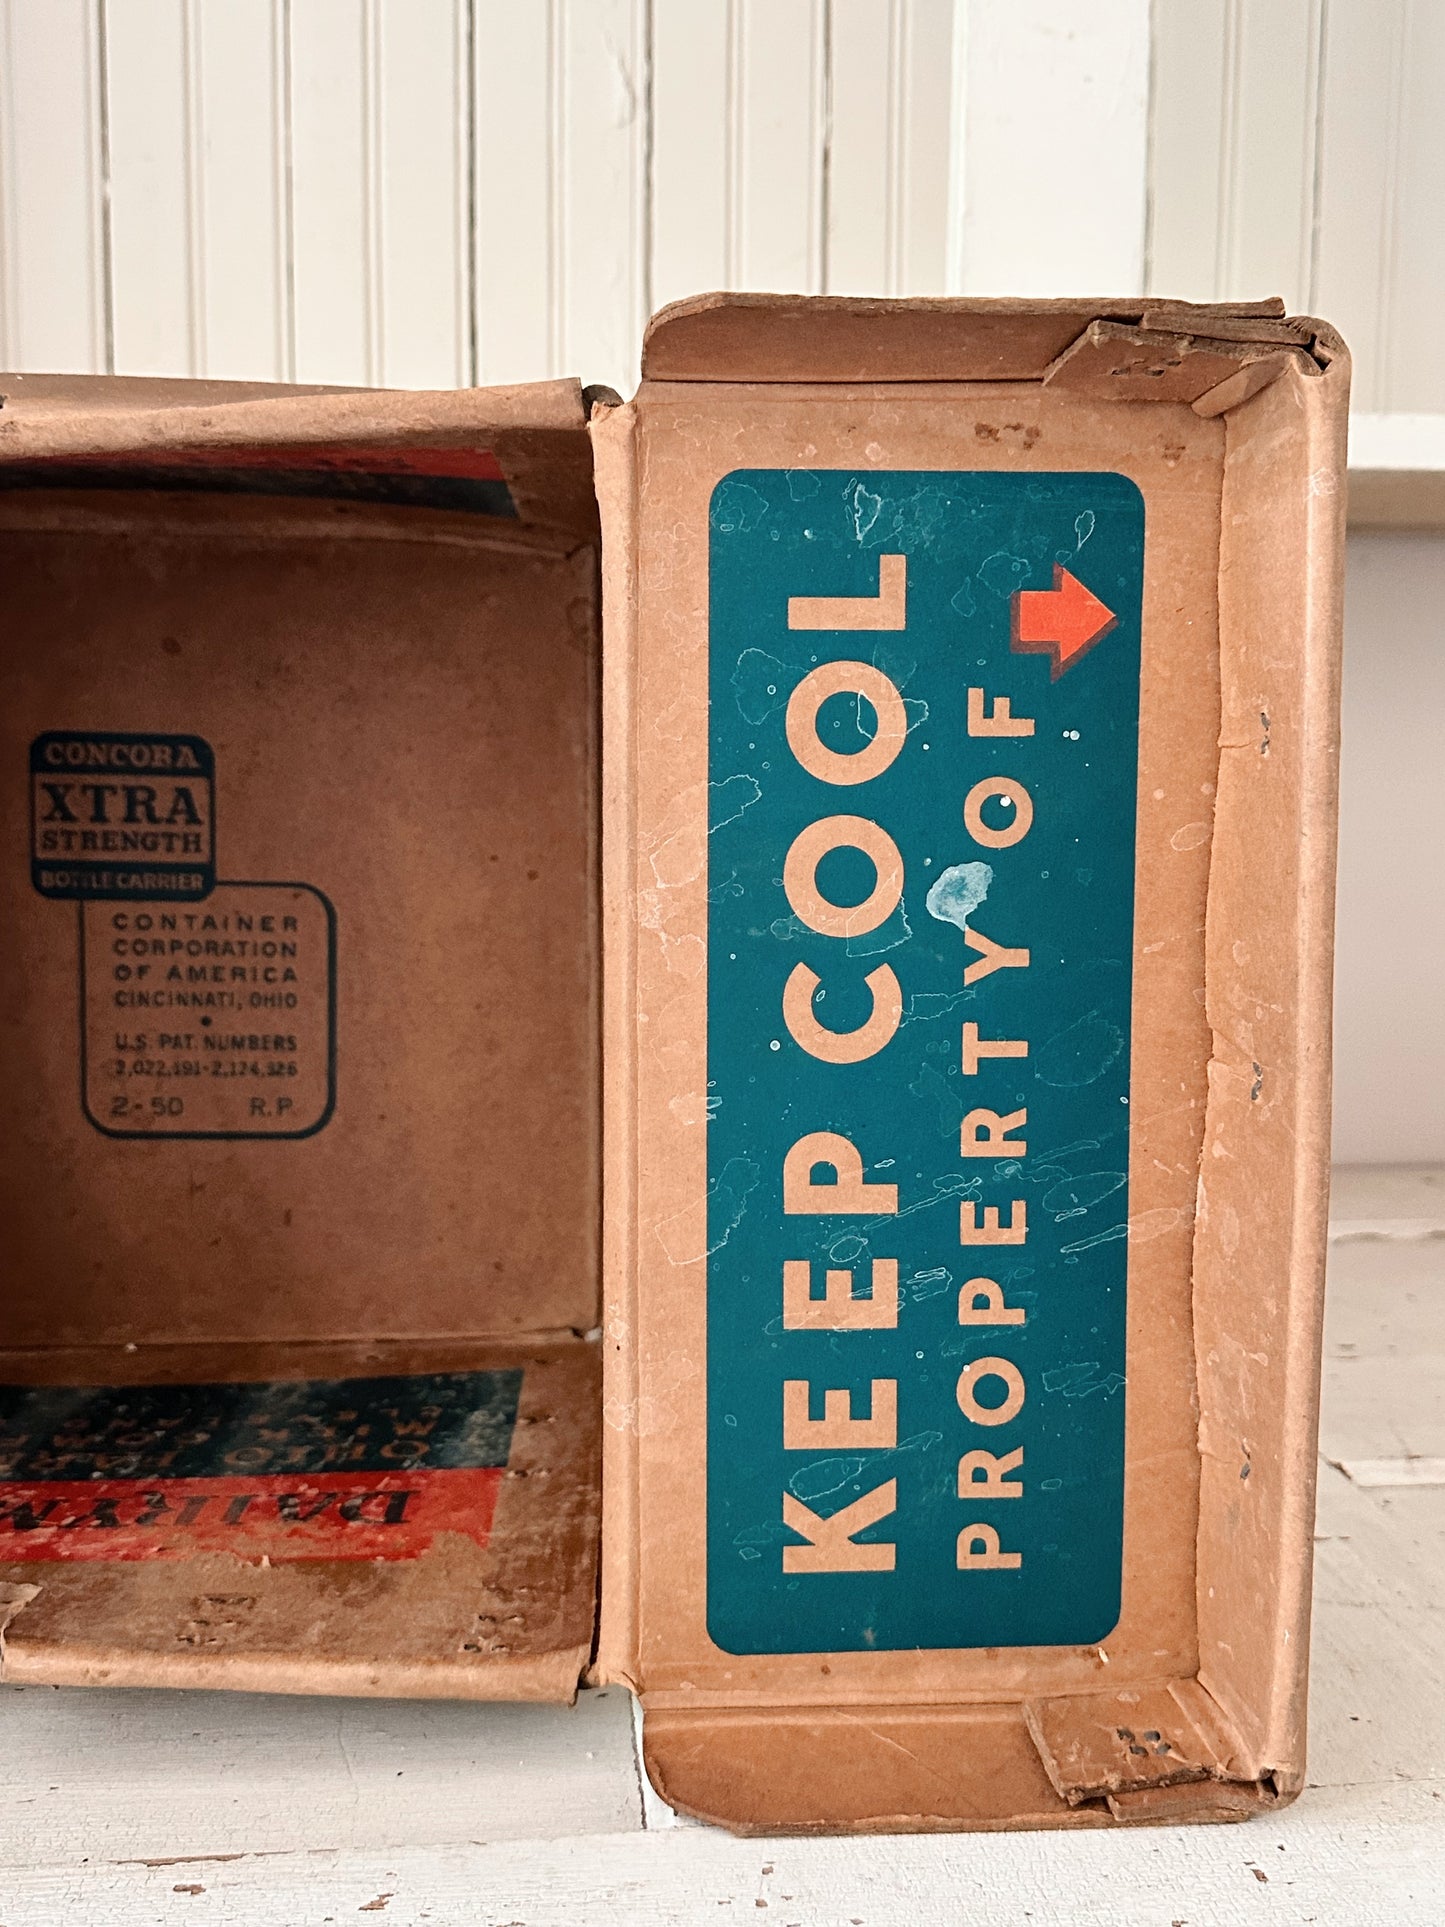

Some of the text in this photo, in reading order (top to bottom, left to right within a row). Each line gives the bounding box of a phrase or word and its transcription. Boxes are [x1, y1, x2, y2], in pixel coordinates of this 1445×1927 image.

[44, 742, 200, 768] CONCORA
[41, 782, 204, 826] XTRA
[40, 829, 204, 854] STRENGTH
[115, 872, 204, 891] CARRIER
[113, 912, 299, 933] CONTAINER
[113, 938, 298, 958] CORPORATION
[114, 963, 298, 983] OF AMERICA
[114, 989, 298, 1010] CINCINNATI, OHIO
[203, 1034, 298, 1052] NUMBERS
[782, 554, 907, 1573] KEEP COOL
[956, 687, 1035, 1570] PROPERTY OF
